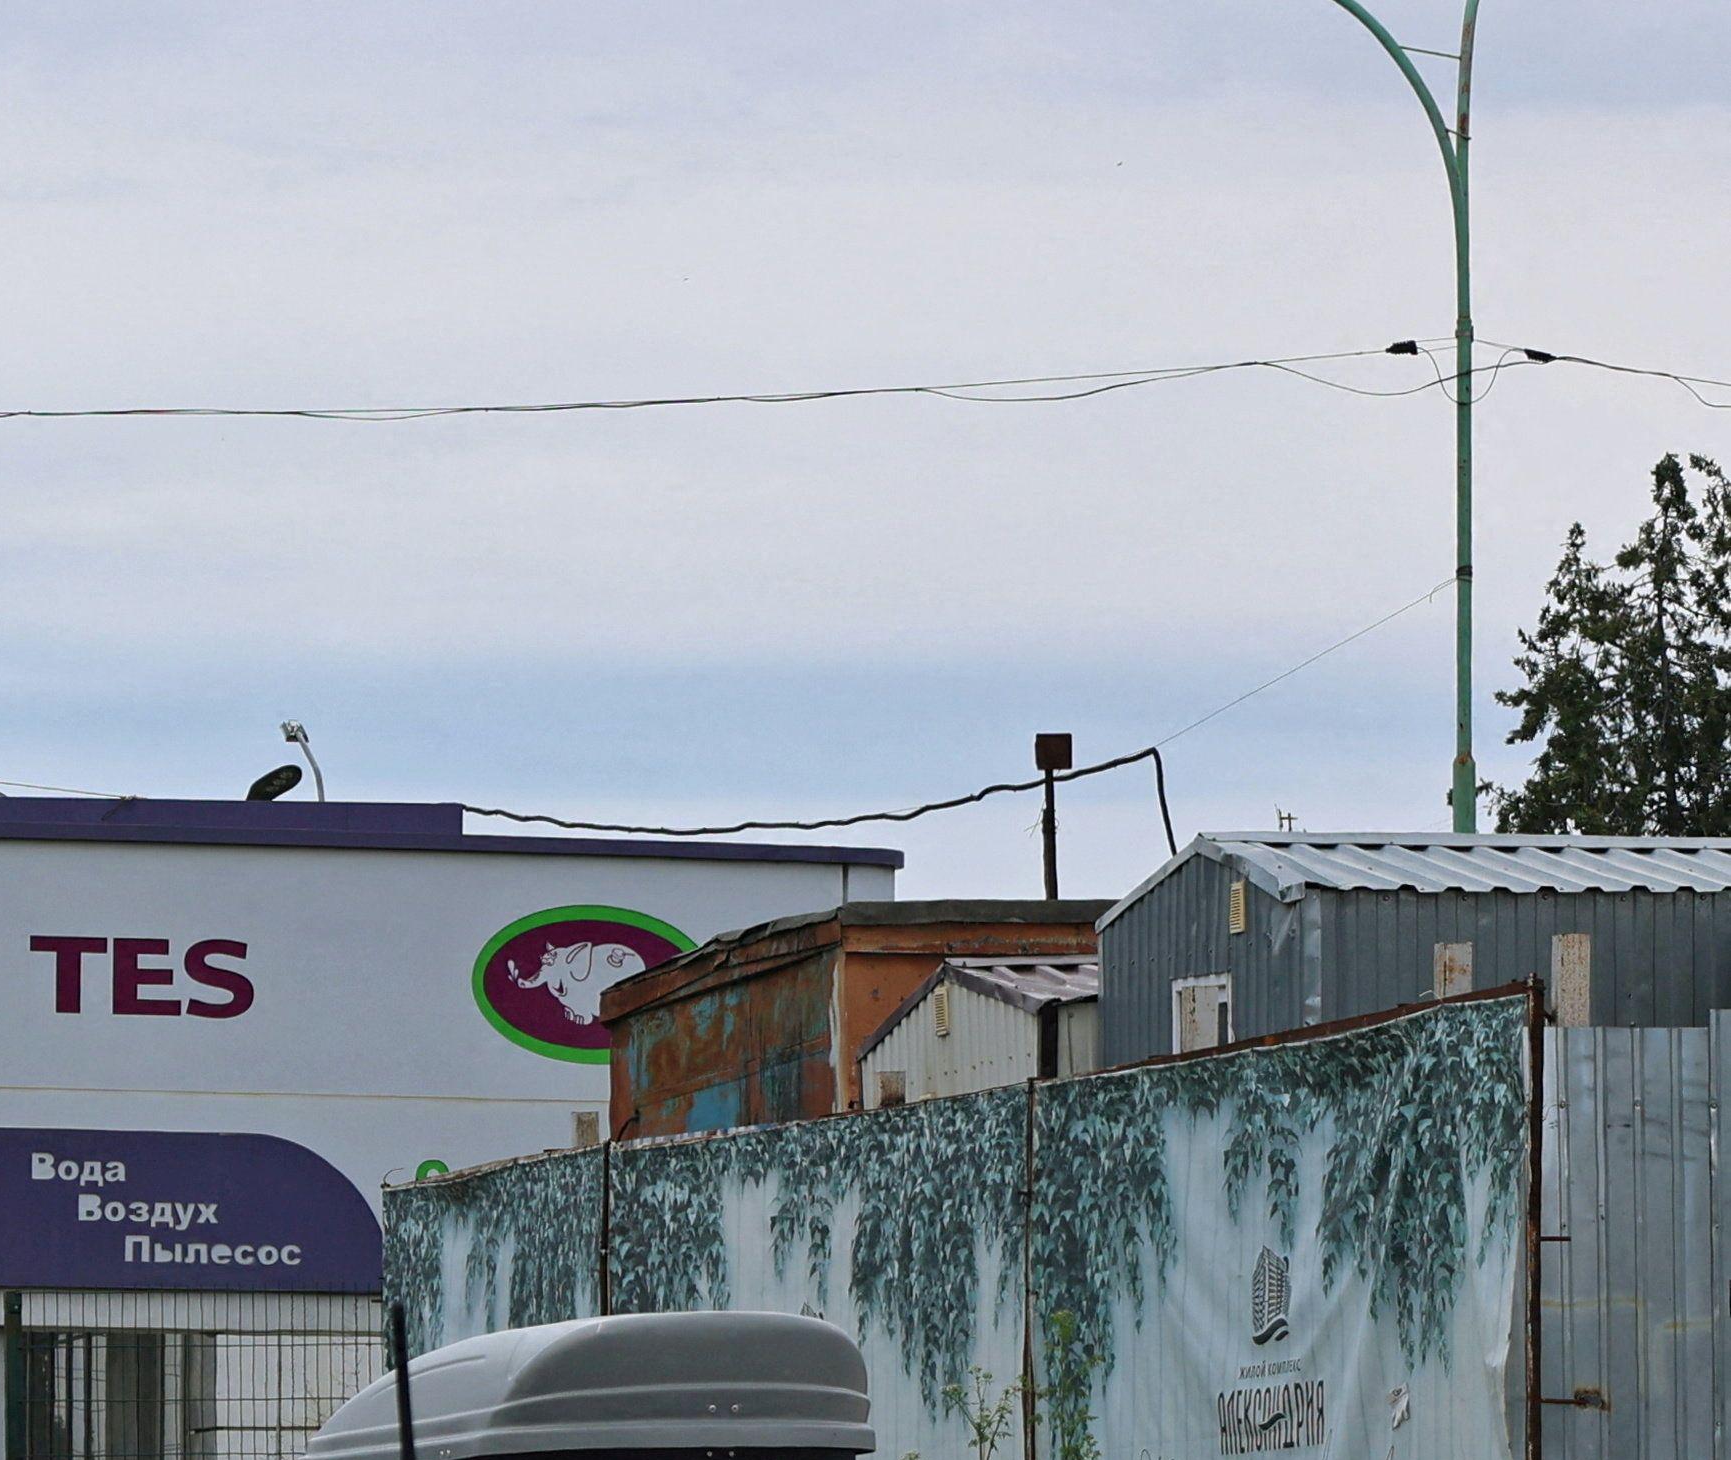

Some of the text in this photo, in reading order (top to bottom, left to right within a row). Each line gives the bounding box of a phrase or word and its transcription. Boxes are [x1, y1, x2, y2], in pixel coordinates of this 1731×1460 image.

[30, 935, 255, 1019] TES
[31, 1152, 126, 1187] Вода
[78, 1194, 218, 1230] Воздух
[124, 1235, 302, 1265] Пылесос
[1239, 1359, 1301, 1379] ЖИЛОЙ КОМПЛЕКС
[1218, 1380, 1324, 1455] АЛЕКСАНДРИЯ
